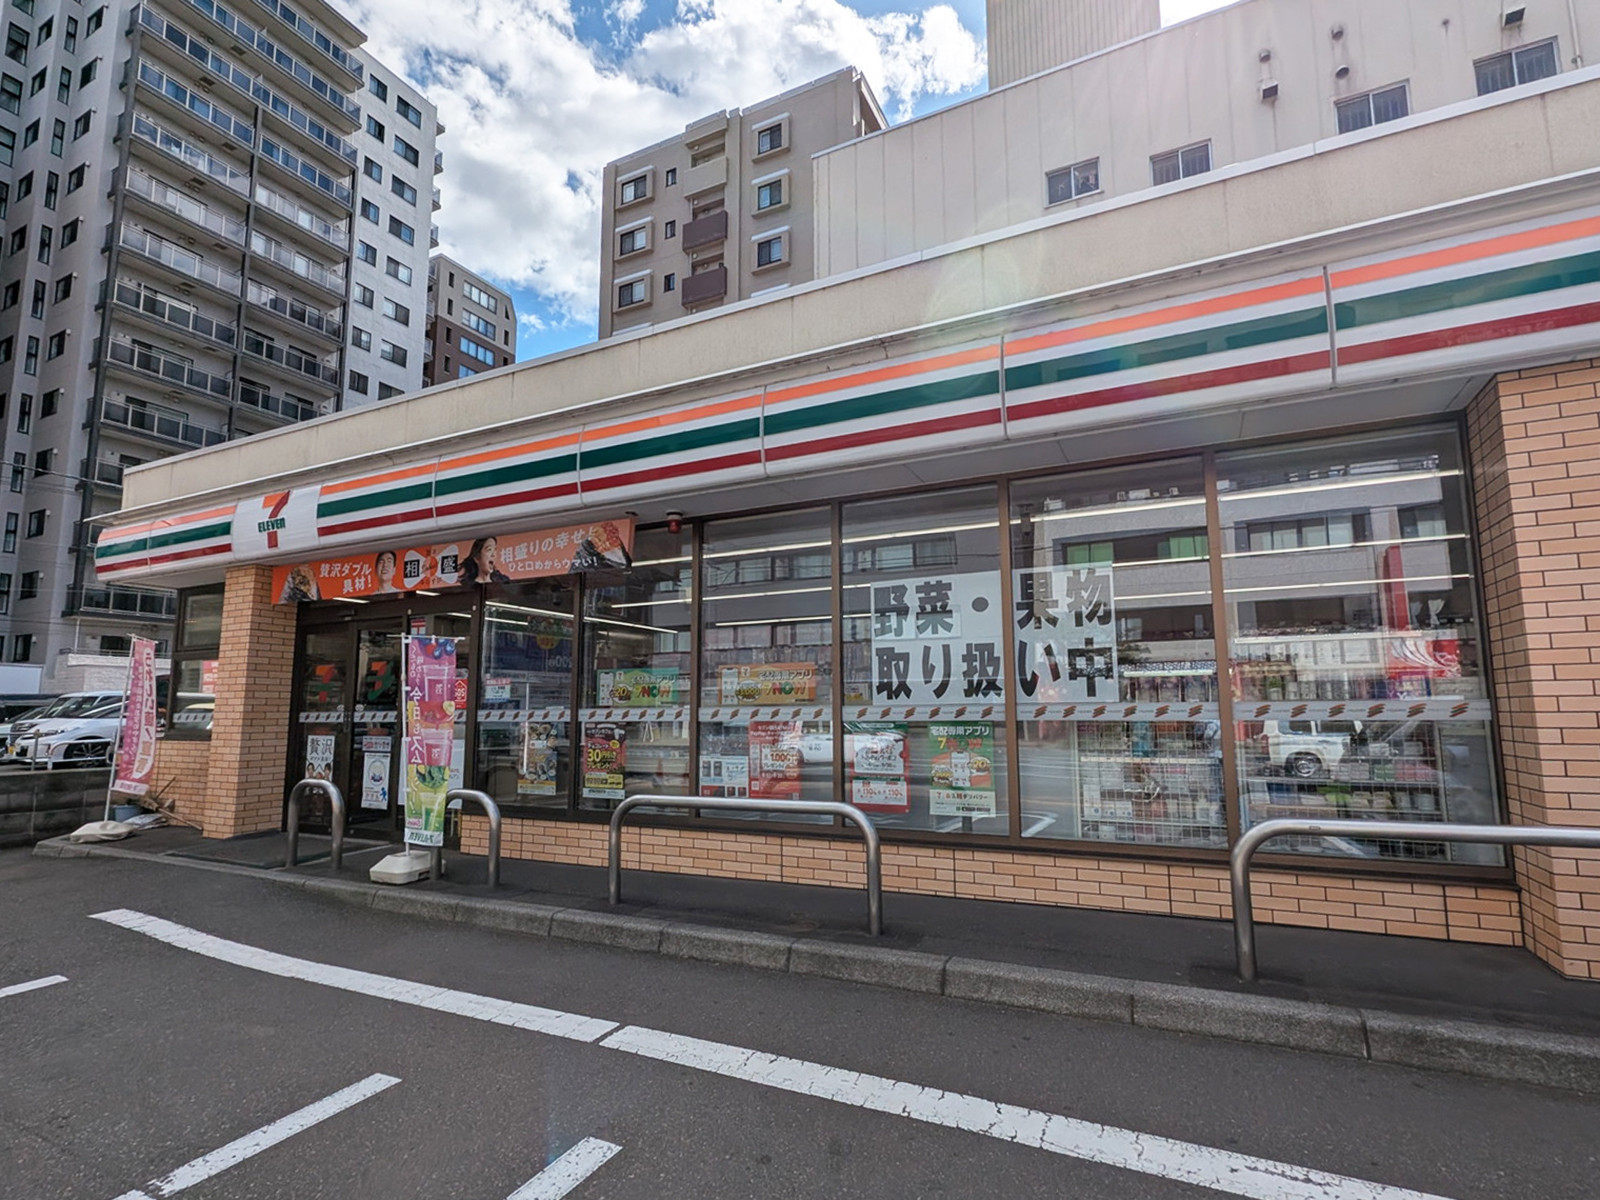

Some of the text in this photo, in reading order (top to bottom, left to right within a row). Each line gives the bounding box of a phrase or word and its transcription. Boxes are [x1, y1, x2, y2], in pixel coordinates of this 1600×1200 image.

[319, 562, 372, 578] 贅沢ダブル
[875, 637, 1113, 700] 取り扱い中
